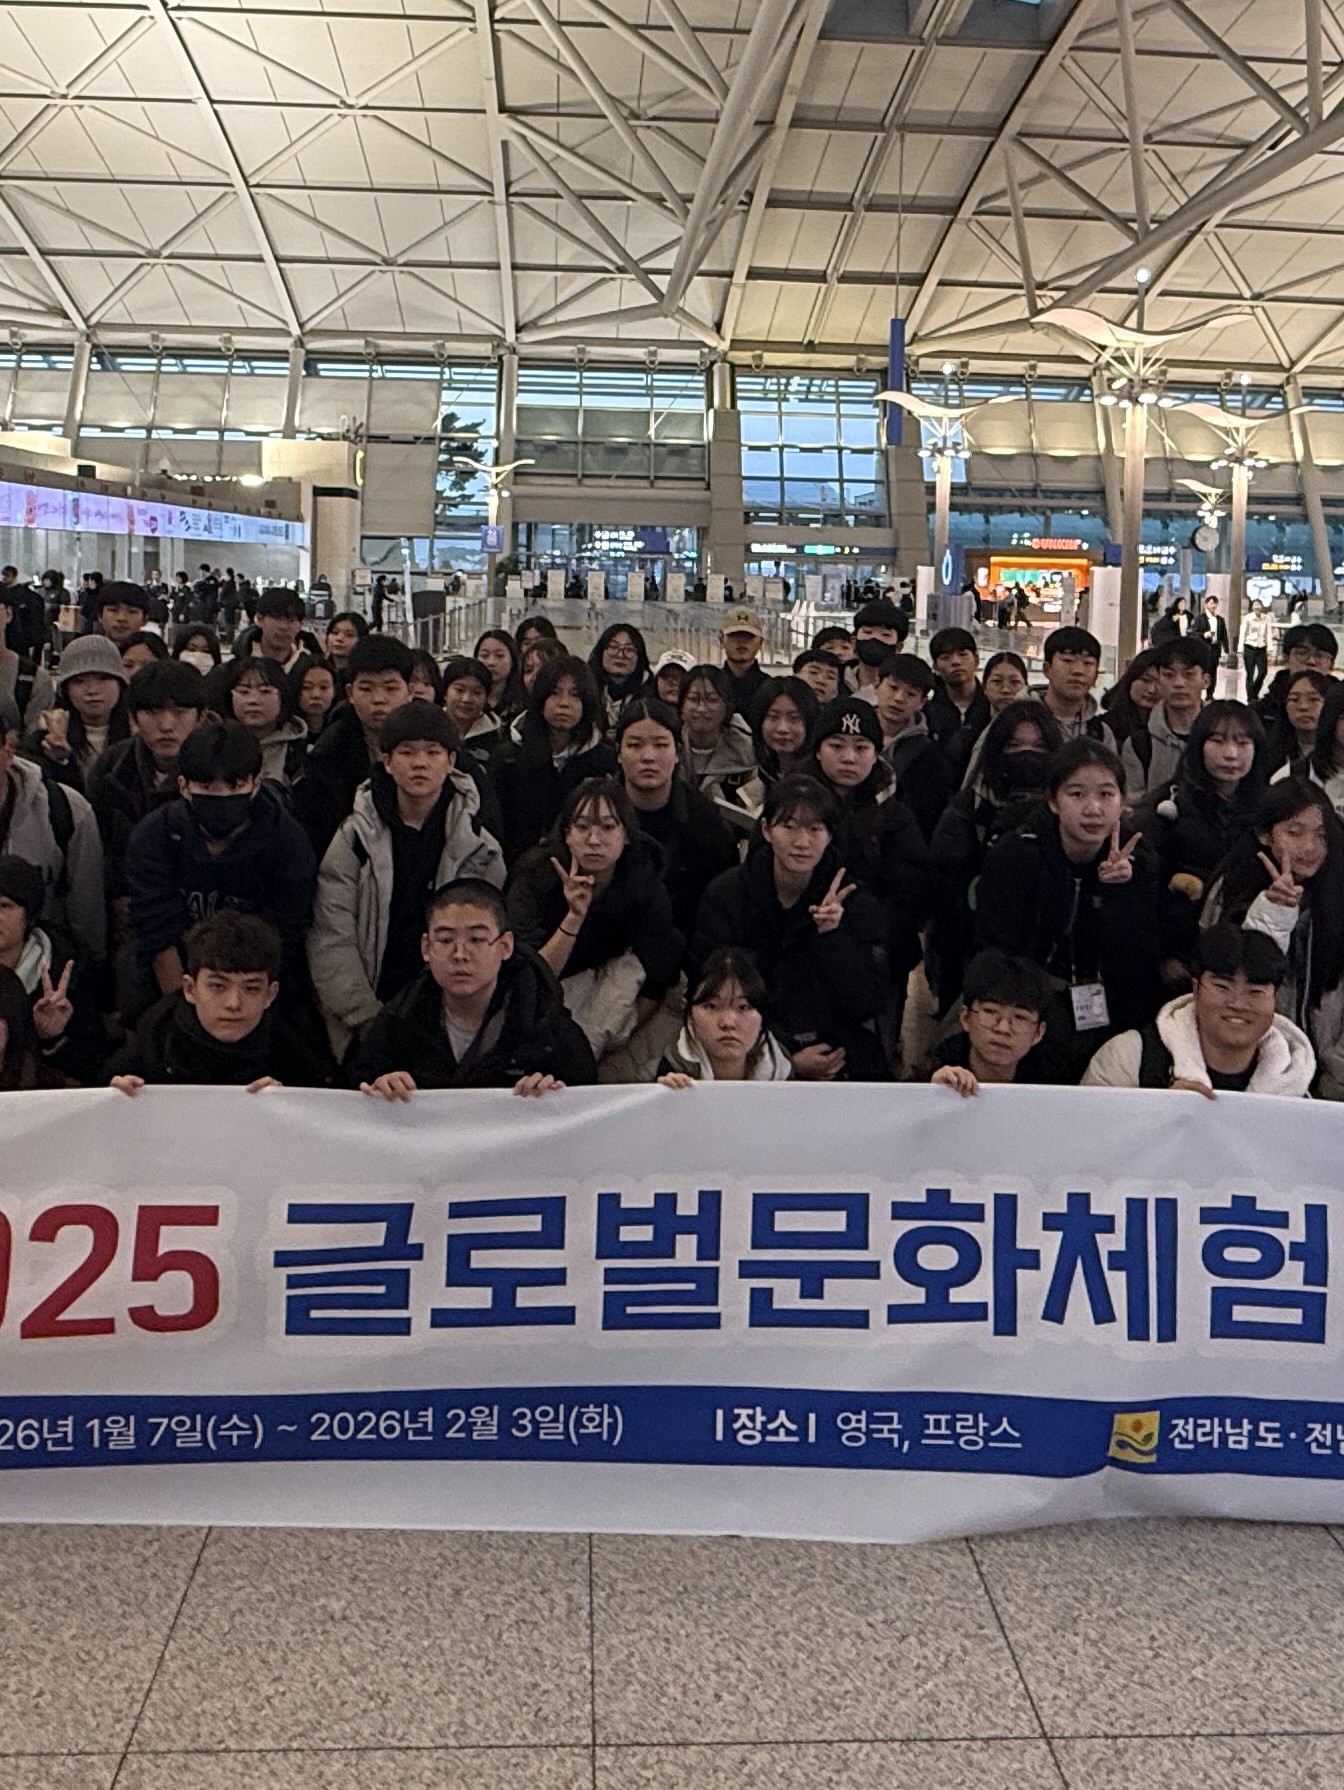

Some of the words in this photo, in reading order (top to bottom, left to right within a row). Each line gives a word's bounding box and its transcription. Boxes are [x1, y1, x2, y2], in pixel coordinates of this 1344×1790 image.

[85, 1414, 136, 1450] 1월
[147, 1412, 265, 1451] 7일(수)
[309, 1407, 435, 1442] 2026년
[445, 1404, 499, 1441] 2월
[510, 1402, 625, 1446] 3일(화)
[835, 1410, 910, 1454] 영국,
[920, 1412, 1023, 1451] 프랑스
